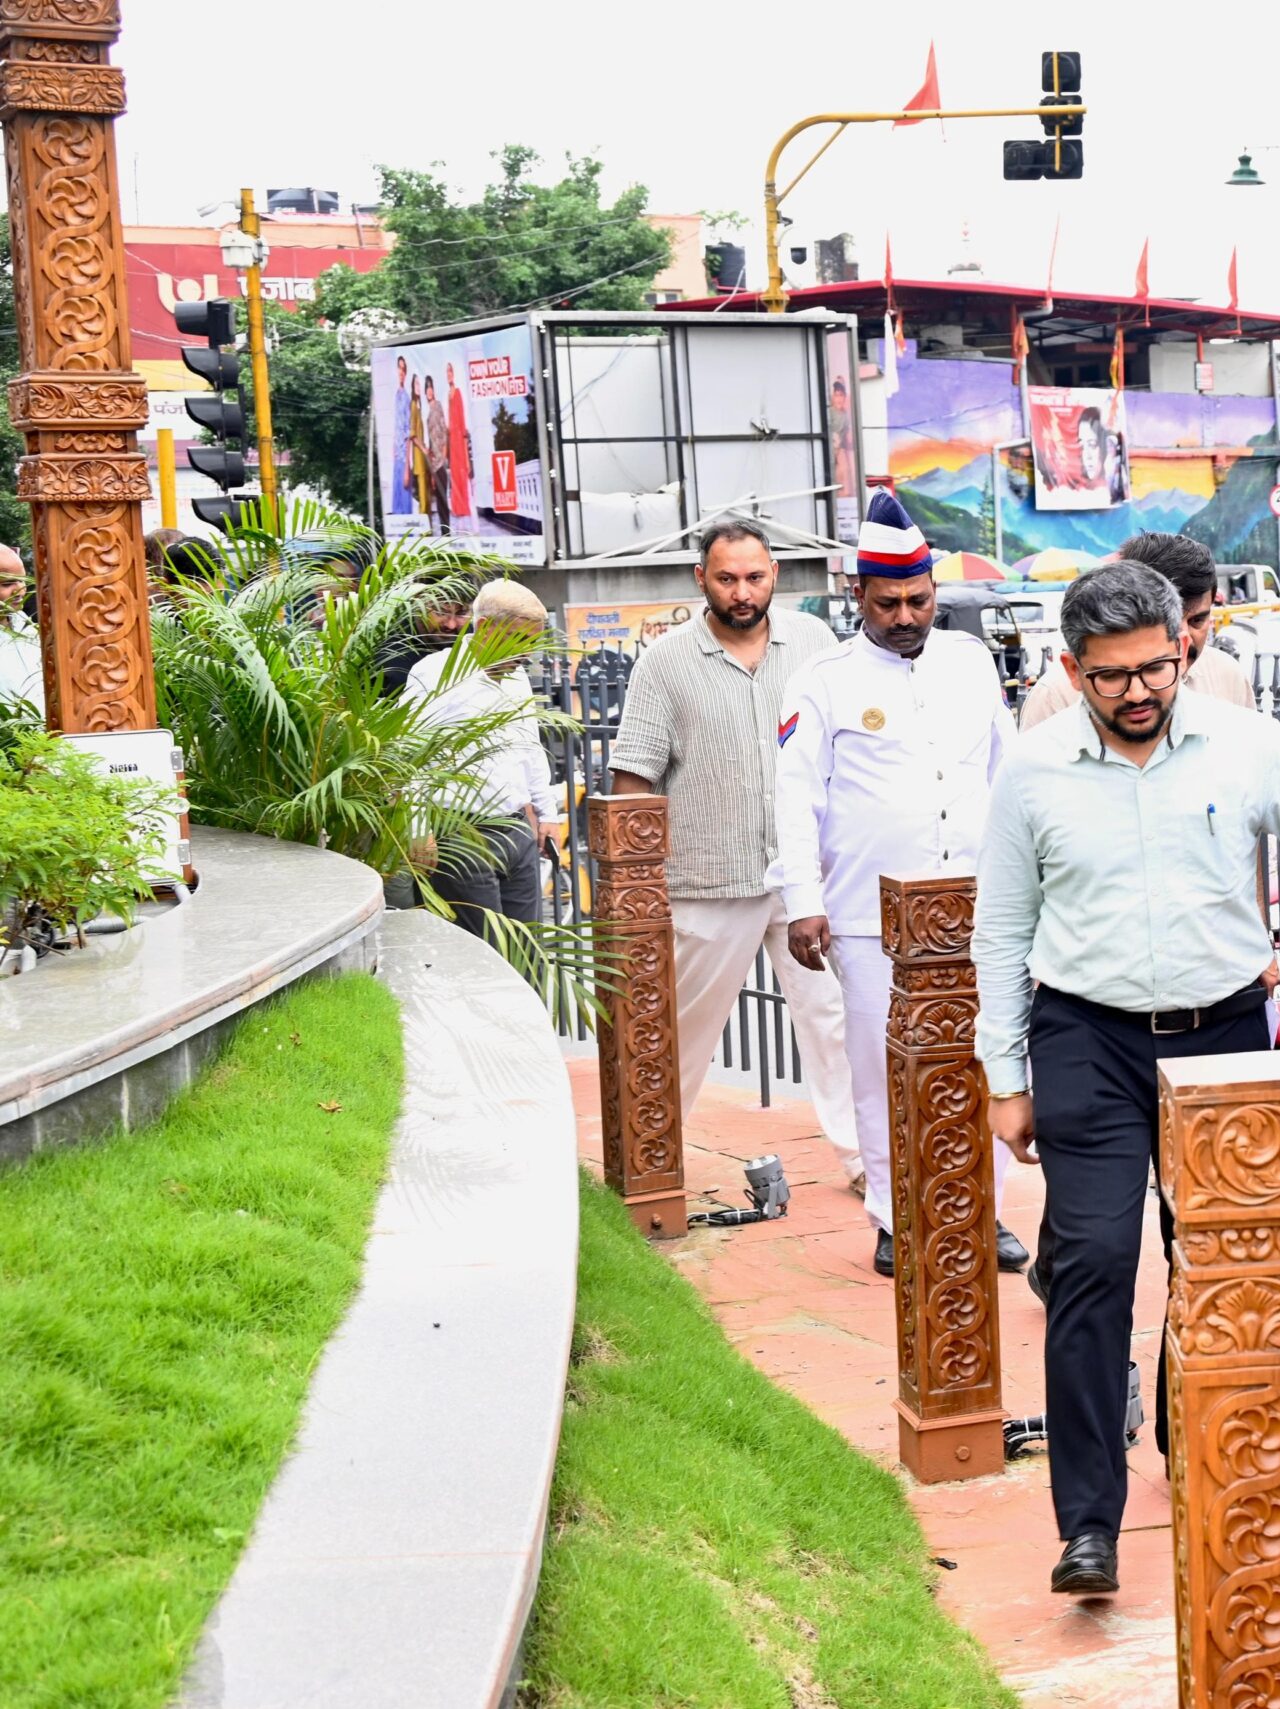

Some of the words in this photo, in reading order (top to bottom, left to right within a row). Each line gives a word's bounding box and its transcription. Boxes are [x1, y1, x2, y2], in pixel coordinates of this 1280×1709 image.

[471, 380, 507, 399] FASHION
[153, 401, 185, 415] पंज
[496, 456, 510, 490] V
